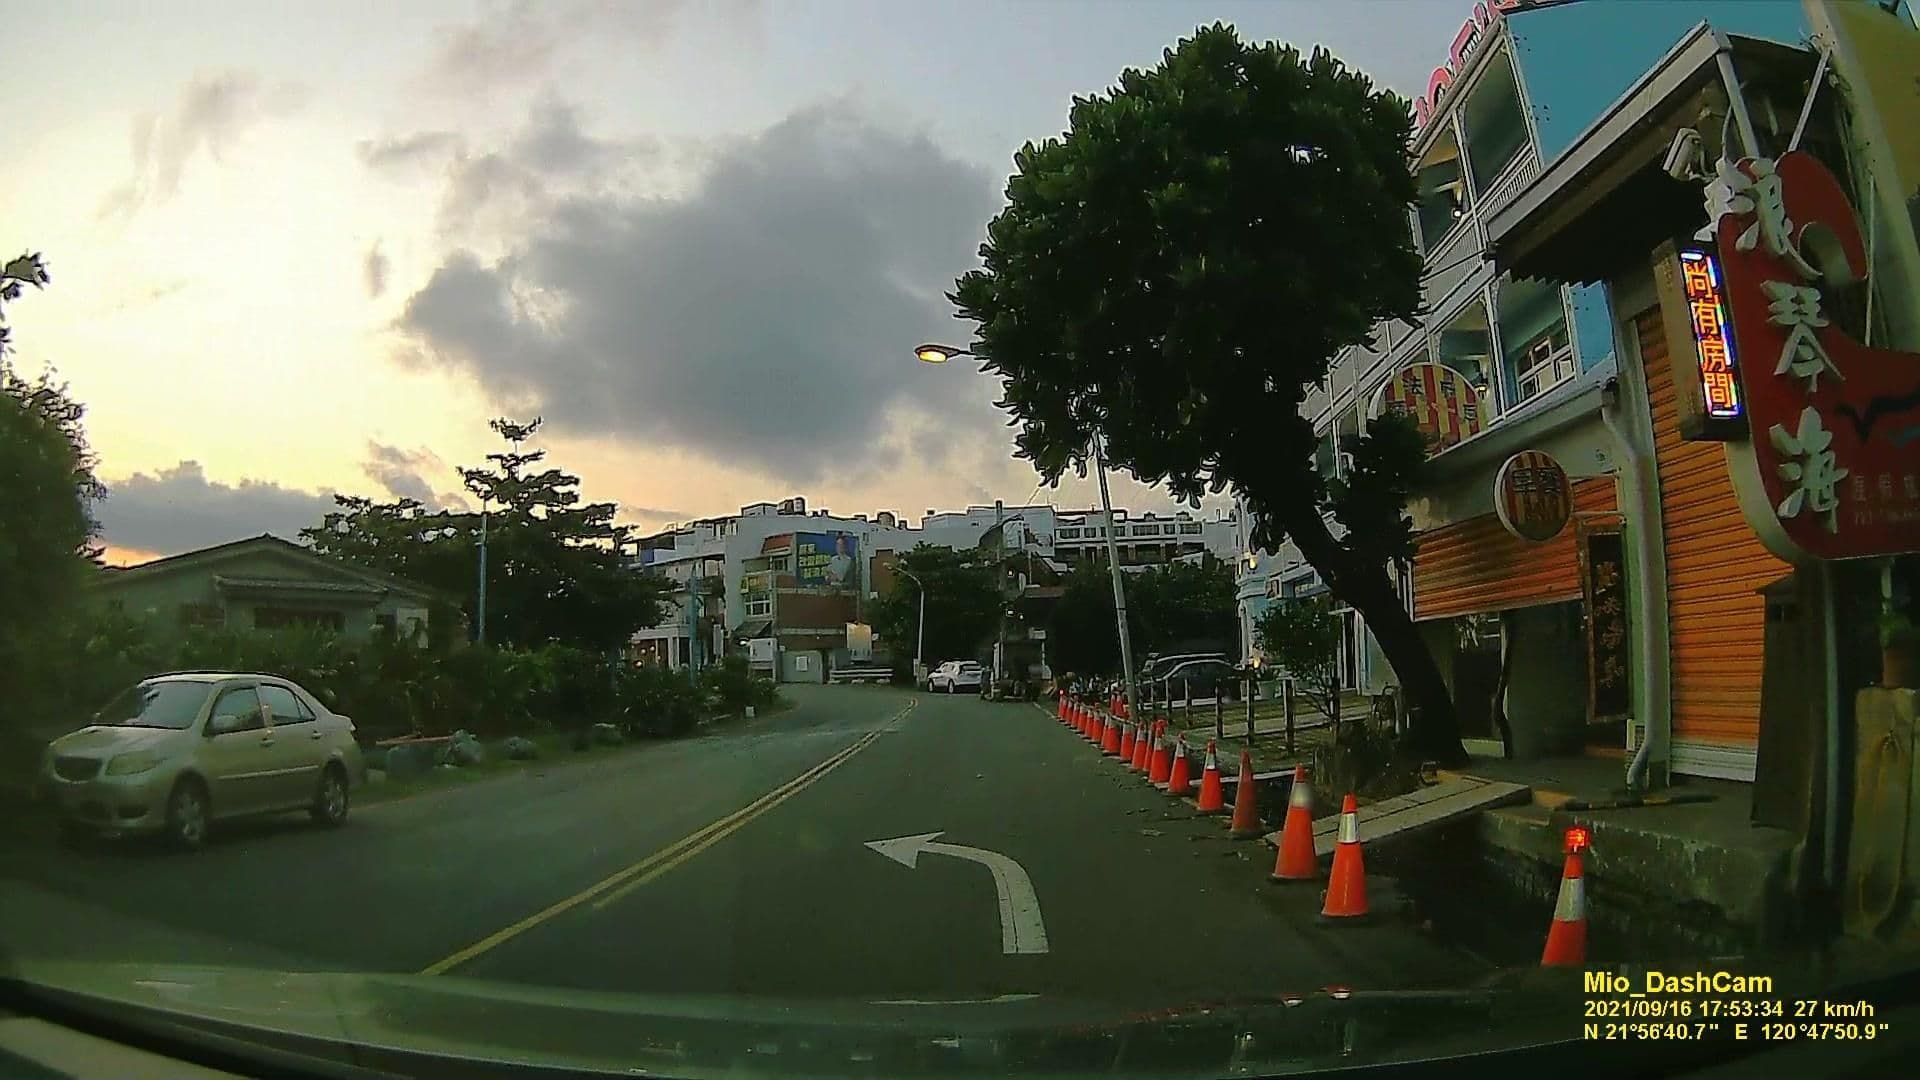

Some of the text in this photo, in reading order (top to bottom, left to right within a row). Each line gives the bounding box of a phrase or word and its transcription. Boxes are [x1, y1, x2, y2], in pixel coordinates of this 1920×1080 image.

[1683, 260, 1734, 409] 尚有房間
[1693, 156, 1849, 534] 浪琴海
